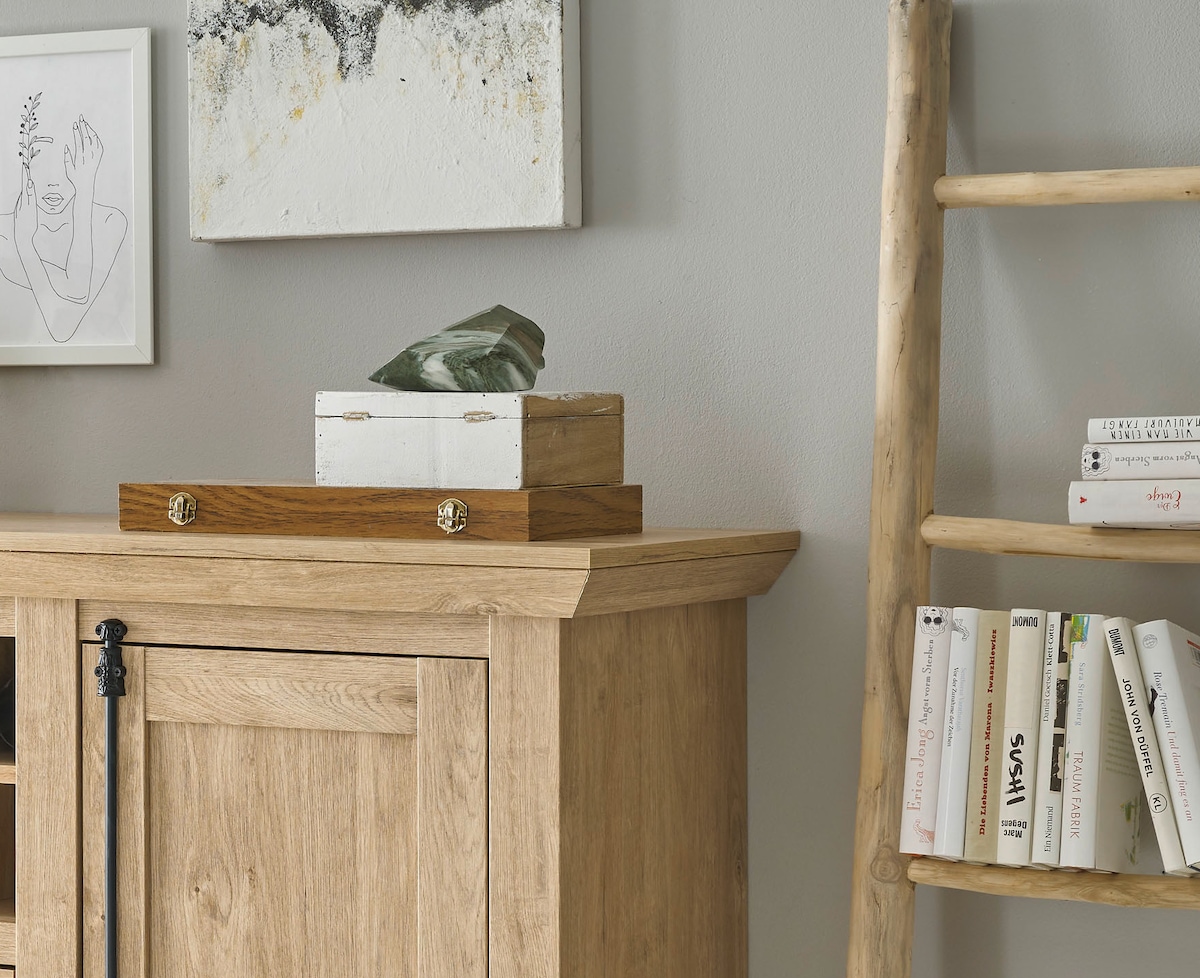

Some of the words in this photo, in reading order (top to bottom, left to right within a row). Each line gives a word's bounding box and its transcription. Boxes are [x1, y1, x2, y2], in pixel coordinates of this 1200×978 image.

[1111, 430, 1141, 440] EINEN
[1147, 429, 1169, 439] MAN
[1114, 456, 1150, 467] Sterben
[1012, 615, 1038, 627] DUMONT
[1046, 623, 1055, 666] Klett-Cotta
[1108, 628, 1125, 656] DUMONT
[922, 639, 934, 674] Sterben
[987, 629, 997, 693] Iwaszkiewicz
[1044, 669, 1052, 698] Goetsch
[1078, 662, 1086, 681] Sara
[1153, 671, 1162, 691] Rose
[918, 699, 933, 725] Angst
[949, 688, 957, 714] Zunahme
[1075, 683, 1085, 726] Stridsberg
[1158, 692, 1173, 729] Tremain
[984, 702, 992, 741] Marona
[1122, 678, 1136, 707] JOHN
[1131, 709, 1143, 733] VON
[1137, 736, 1154, 778] DÜFFEL
[910, 729, 934, 767] Jong
[1167, 731, 1179, 750] Und
[1005, 733, 1026, 806] SUSHI
[1071, 750, 1084, 793] TRAUM
[1172, 752, 1185, 777] damit
[906, 771, 924, 810] Erica
[980, 765, 989, 816] Liebenden
[1175, 779, 1188, 797] fing
[1152, 796, 1162, 811] KL
[1183, 798, 1190, 808] es
[1185, 810, 1193, 822] an
[1001, 820, 1028, 830] Degens
[1045, 806, 1054, 839] Niemand
[1069, 796, 1082, 839] FABRIK
[1003, 829, 1023, 838] Marc
[1044, 840, 1052, 852] Ein
